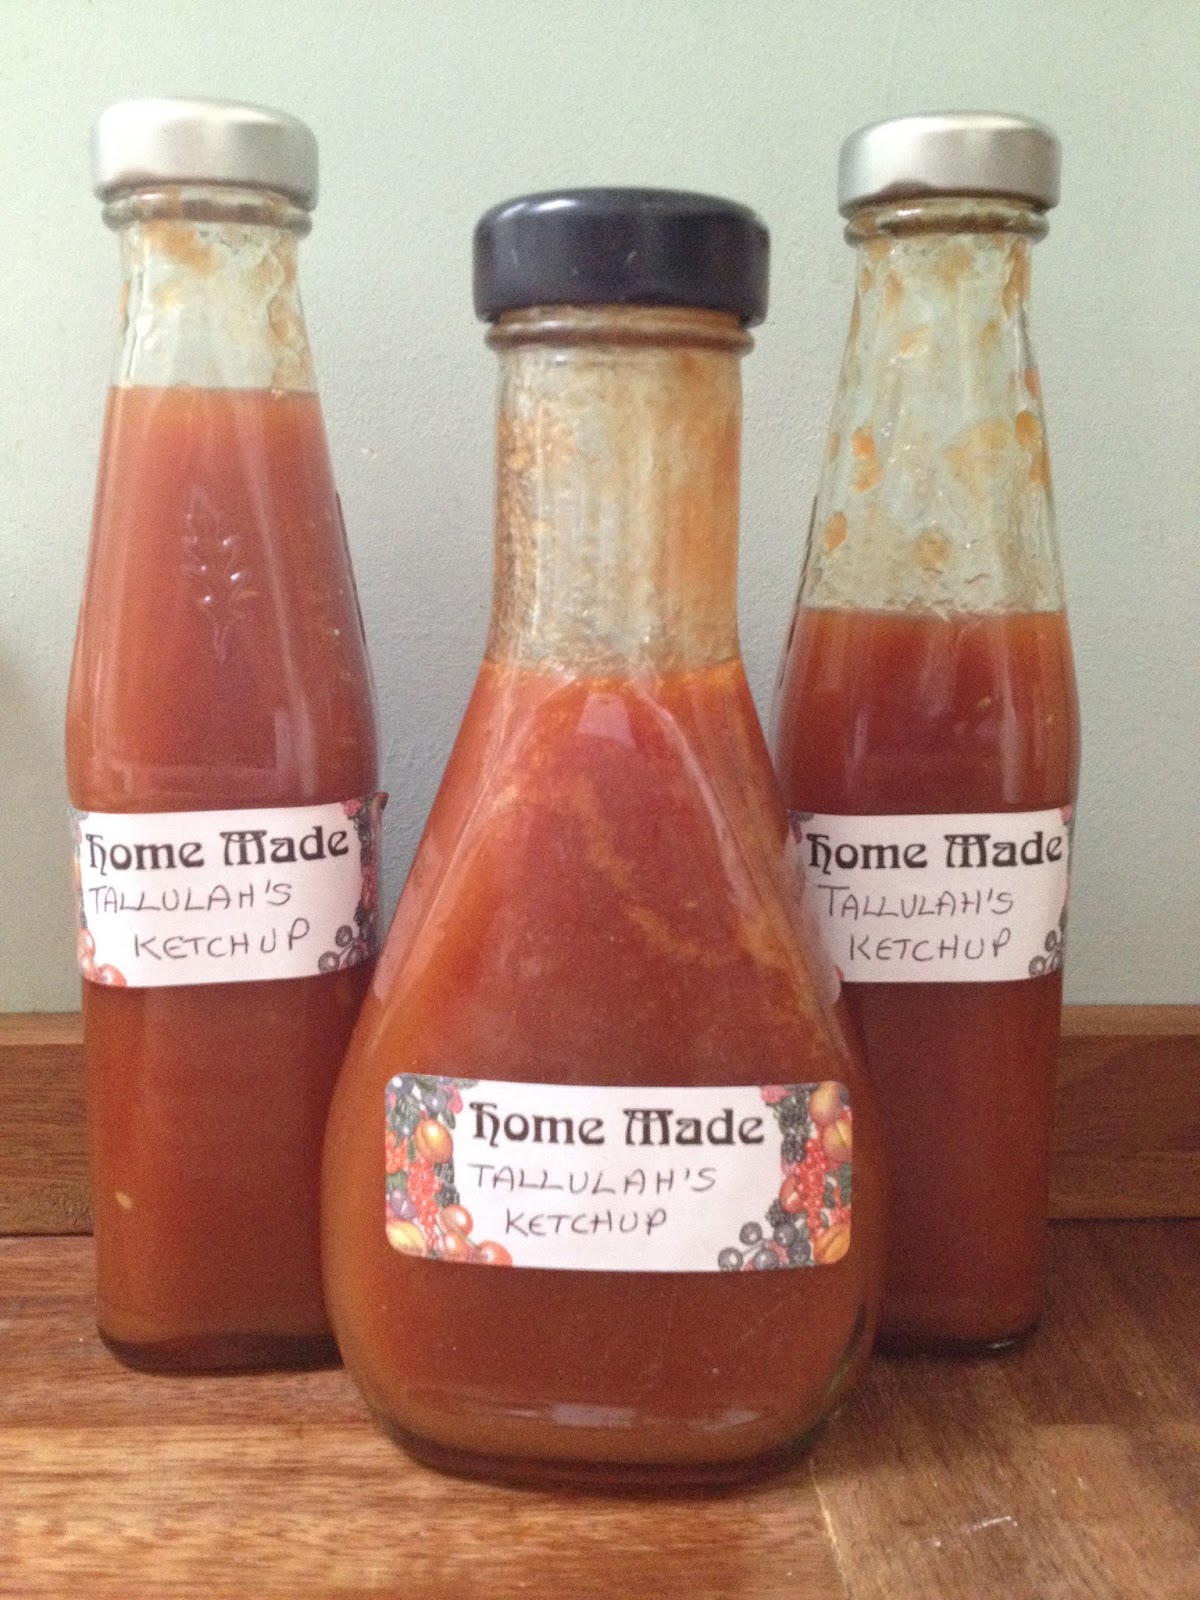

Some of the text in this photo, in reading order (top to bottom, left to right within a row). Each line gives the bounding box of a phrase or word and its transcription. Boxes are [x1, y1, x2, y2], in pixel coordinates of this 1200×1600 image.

[86, 826, 349, 875] Home Made
[806, 831, 1062, 874] Home Made
[88, 879, 293, 913] TALLULAH'S
[817, 884, 1014, 920] TALLULAH'S
[133, 917, 310, 960] KETCHUP
[850, 927, 1011, 962] KETCHUP
[469, 1101, 765, 1147] Home Made
[467, 1162, 718, 1195] TALLULAH'S
[504, 1208, 668, 1236] KETCHUP
